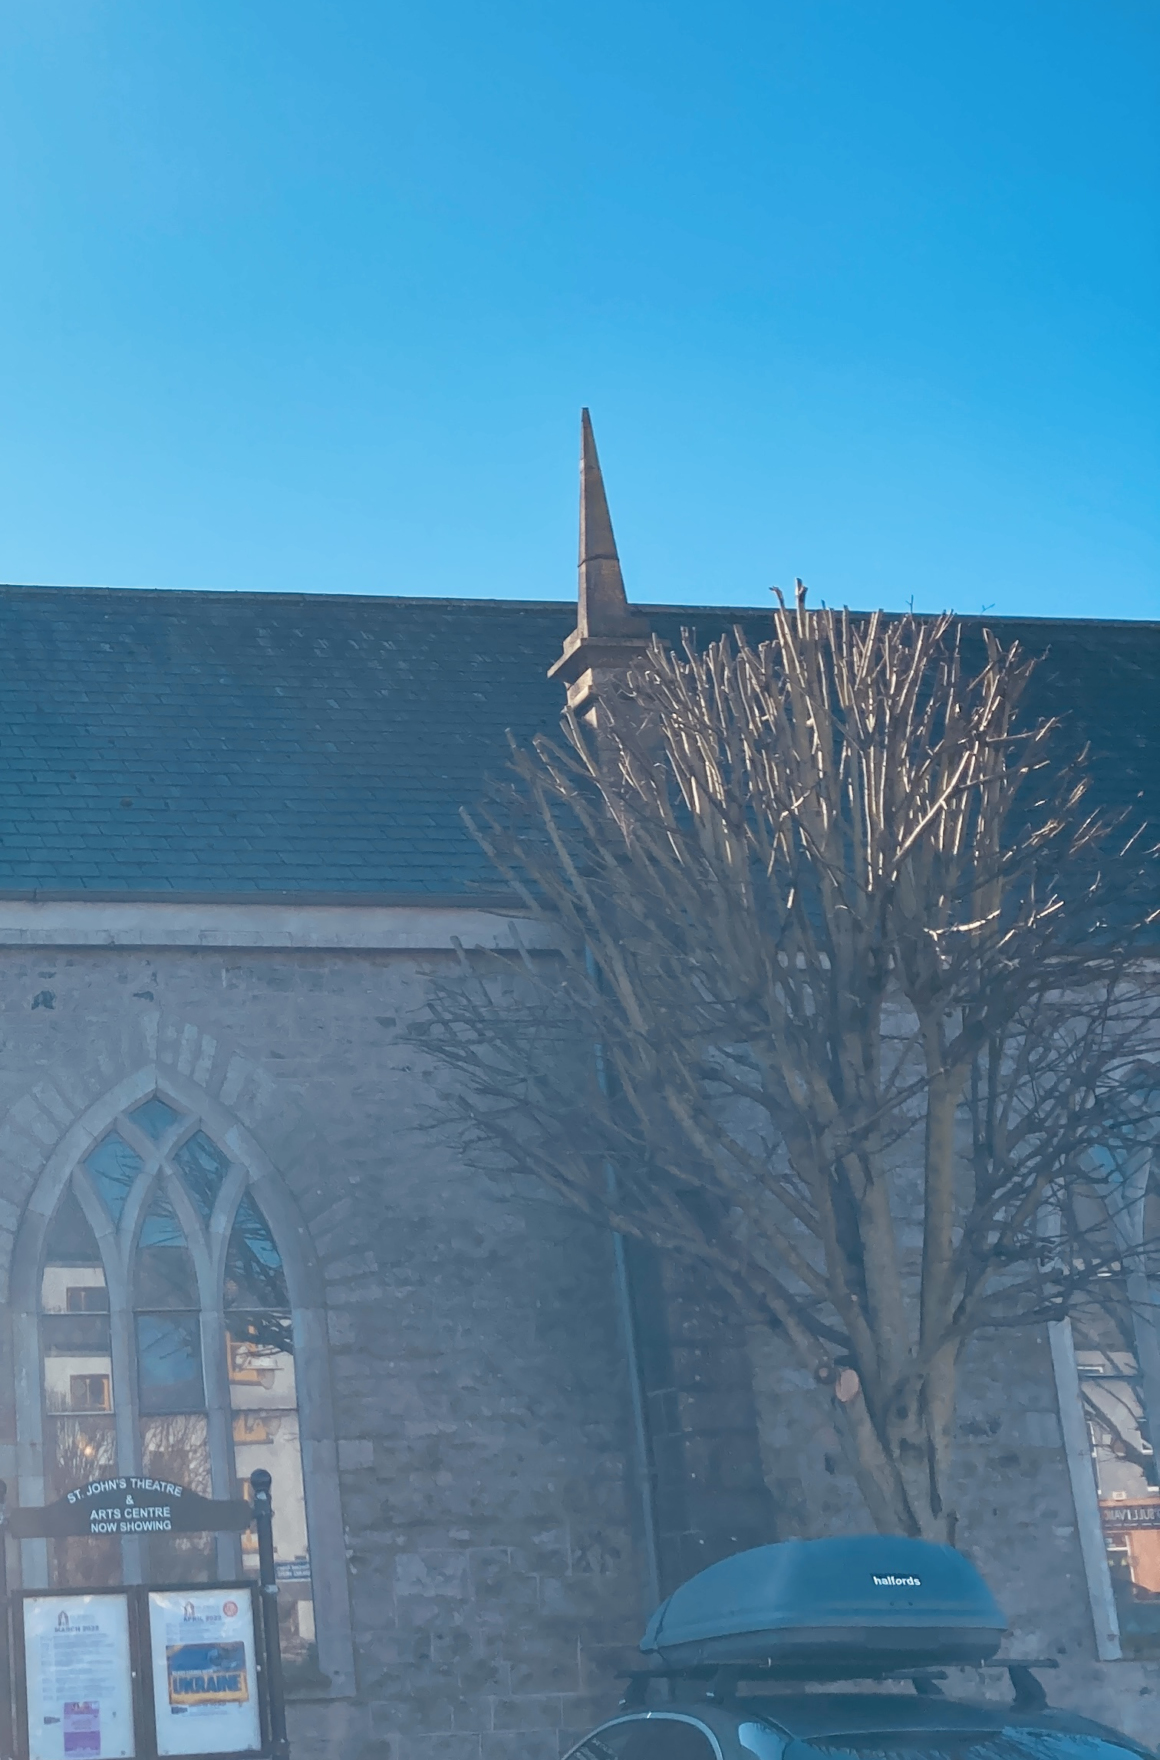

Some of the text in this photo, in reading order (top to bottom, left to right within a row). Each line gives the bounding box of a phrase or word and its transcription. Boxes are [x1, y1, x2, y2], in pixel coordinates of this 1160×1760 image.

[67, 1477, 183, 1504] ST. JOHN'S THEATRE
[125, 1495, 134, 1505] &
[90, 1506, 171, 1520] ARTS CENTRE
[91, 1520, 171, 1533] NOW SHOWING
[873, 1576, 921, 1585] halfords
